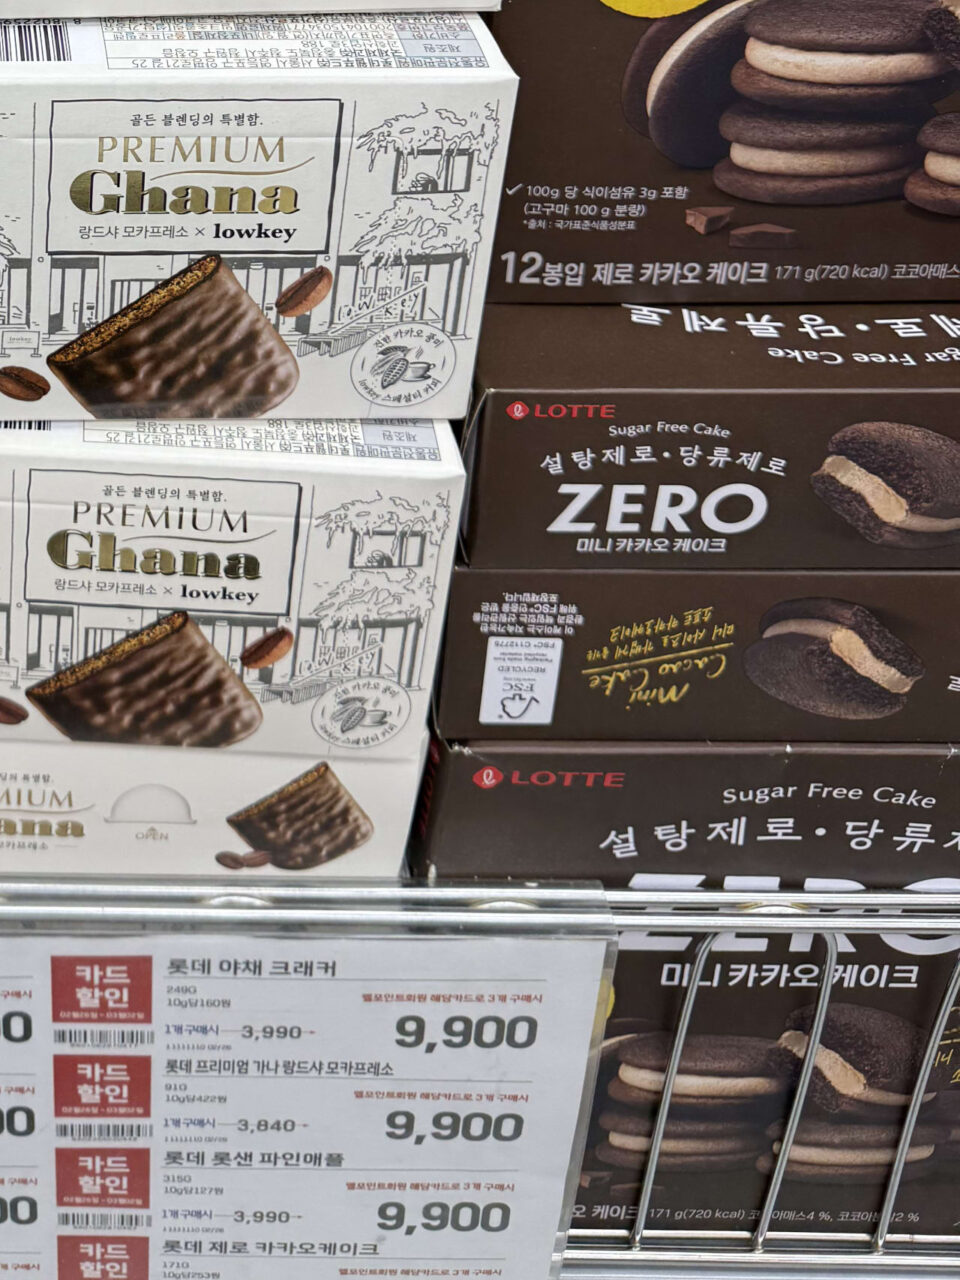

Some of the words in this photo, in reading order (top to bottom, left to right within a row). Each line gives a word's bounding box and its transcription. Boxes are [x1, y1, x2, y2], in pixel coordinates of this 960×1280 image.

[129, 113, 158, 127] 골든
[162, 112, 214, 127] 블렌딩의
[219, 112, 264, 127] 특별함.
[98, 135, 286, 164] PREMIUM
[69, 169, 301, 216] Ghana
[526, 186, 560, 200] 100g
[564, 184, 579, 199] 당
[639, 187, 657, 200] 3g
[661, 185, 689, 200] 포함
[78, 225, 118, 240] 랑드샤
[121, 225, 189, 240] 모카프레소
[214, 222, 298, 245] lowkey
[500, 251, 584, 286] 12봉입
[592, 262, 634, 286] 제로
[640, 263, 701, 285] 카카오
[706, 263, 768, 286] 케이크
[775, 264, 800, 279] 171
[534, 404, 616, 418] LOTTE
[608, 422, 651, 438] Sugar
[656, 421, 688, 433] Free
[693, 422, 731, 438] Cake
[73, 501, 250, 534] PREMIUM
[546, 483, 769, 534] ZERO
[46, 528, 264, 581] Ghana
[576, 537, 612, 553] 미니
[615, 538, 669, 552] 카카오
[673, 537, 727, 552] 케이크
[54, 578, 92, 593] 랑드샤
[95, 580, 158, 595] 모카프레소
[181, 584, 259, 605] lowkey
[512, 771, 626, 788] LOTTE
[723, 785, 797, 804] Sugar
[807, 782, 864, 800] Free
[873, 786, 937, 809] Cake
[76, 965, 130, 985] 카드
[167, 958, 211, 976] 롯데
[219, 958, 262, 976] 야채
[269, 960, 337, 978] 크래커
[76, 987, 130, 1008] 할인
[241, 1025, 303, 1041] 3,990
[395, 1015, 538, 1054] 9,900
[77, 1063, 130, 1081] 카드
[165, 1058, 193, 1075] 롯데
[195, 1059, 249, 1075] 프리미엄
[253, 1060, 280, 1075] 가나
[326, 1061, 394, 1077] 모카프레소
[237, 1119, 296, 1133] 3,840
[385, 1110, 524, 1145] 9,900
[164, 1152, 205, 1166] 롯데
[212, 1152, 253, 1167] 롯샌
[260, 1152, 345, 1167] 파인애플
[234, 1210, 290, 1223] 3,990
[377, 1201, 511, 1236] 9,900
[162, 1241, 202, 1254] 롯데
[209, 1242, 249, 1255] 제로
[255, 1242, 379, 1256] 카카오케이크
